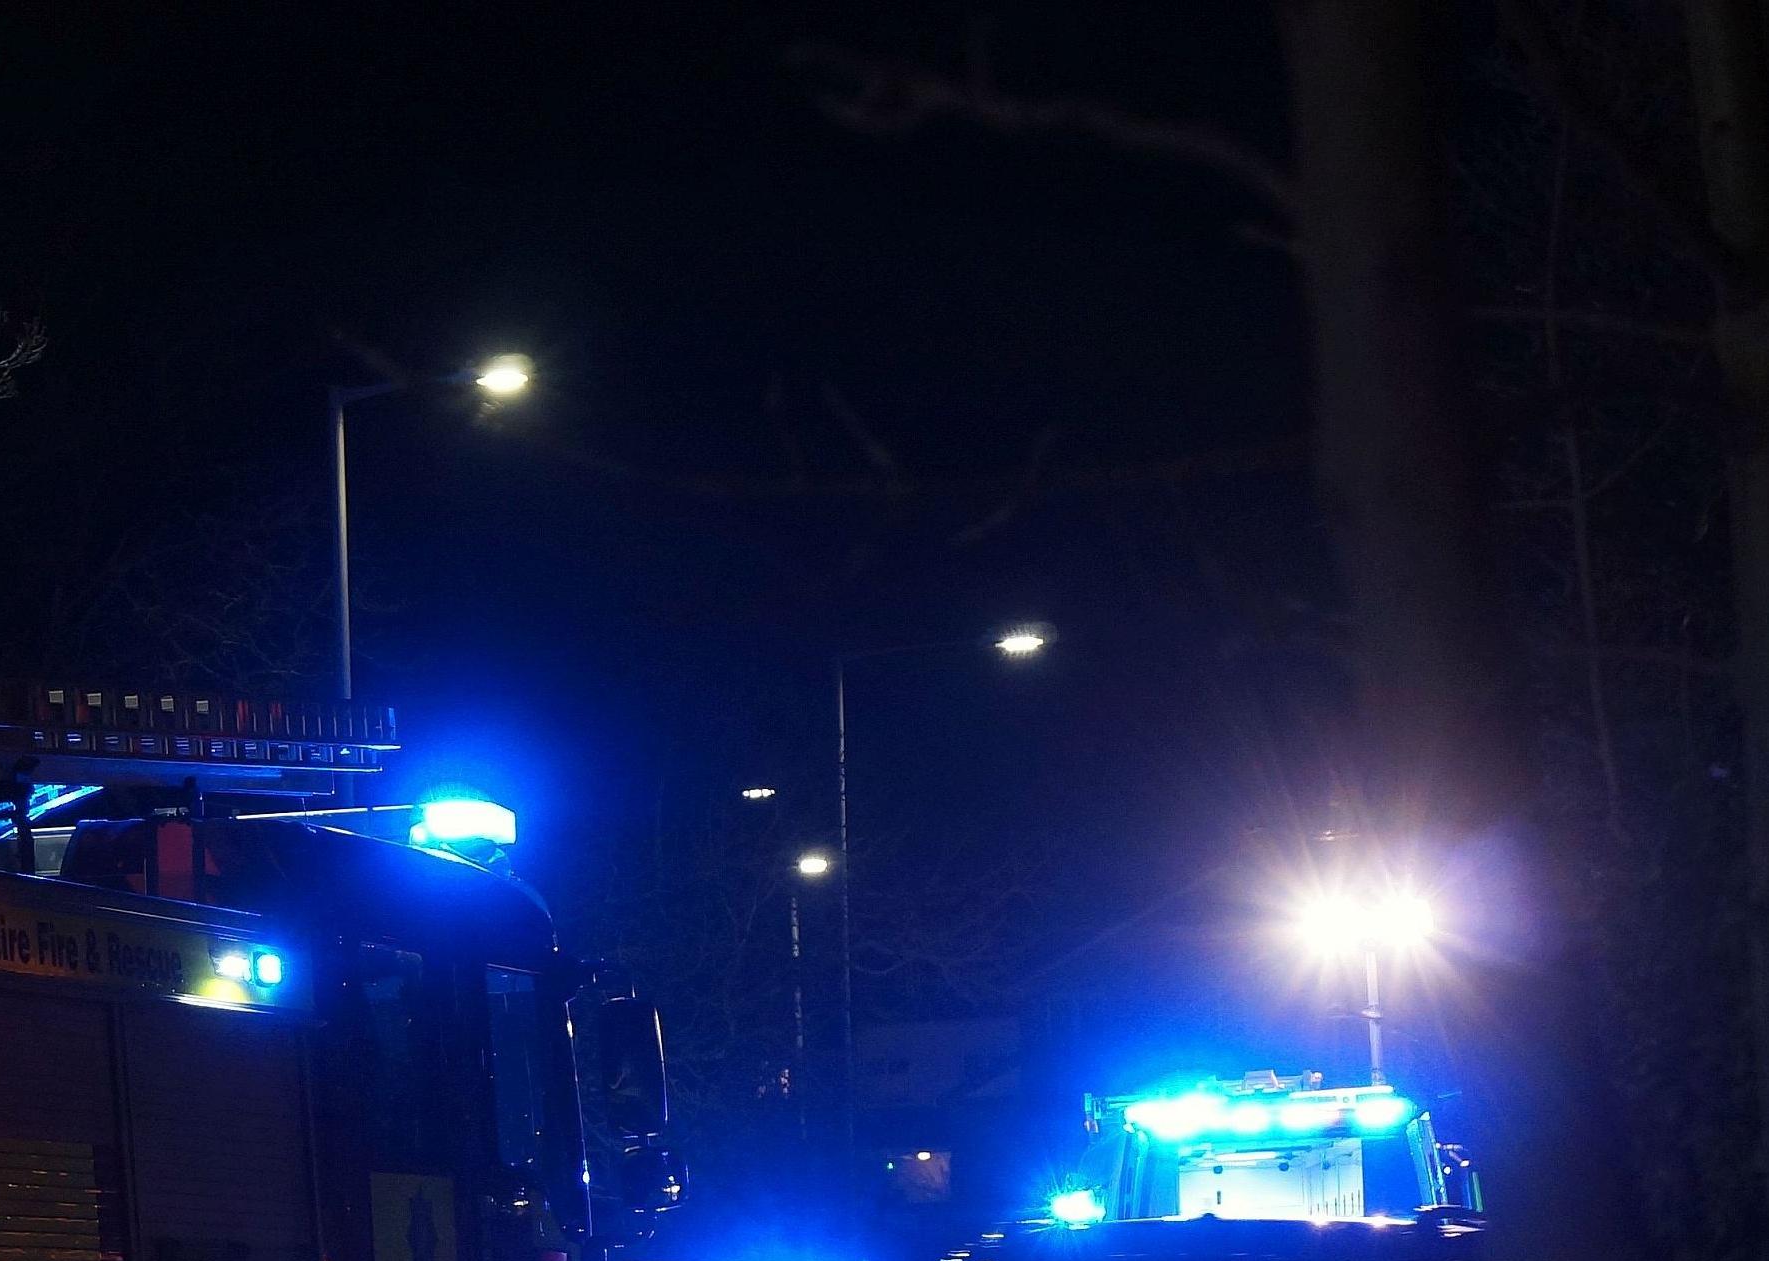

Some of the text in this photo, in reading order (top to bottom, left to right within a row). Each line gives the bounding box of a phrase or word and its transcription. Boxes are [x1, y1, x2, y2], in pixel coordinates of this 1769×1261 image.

[37, 921, 79, 971] Fire
[85, 927, 101, 973] &
[107, 932, 182, 980] Rescue
